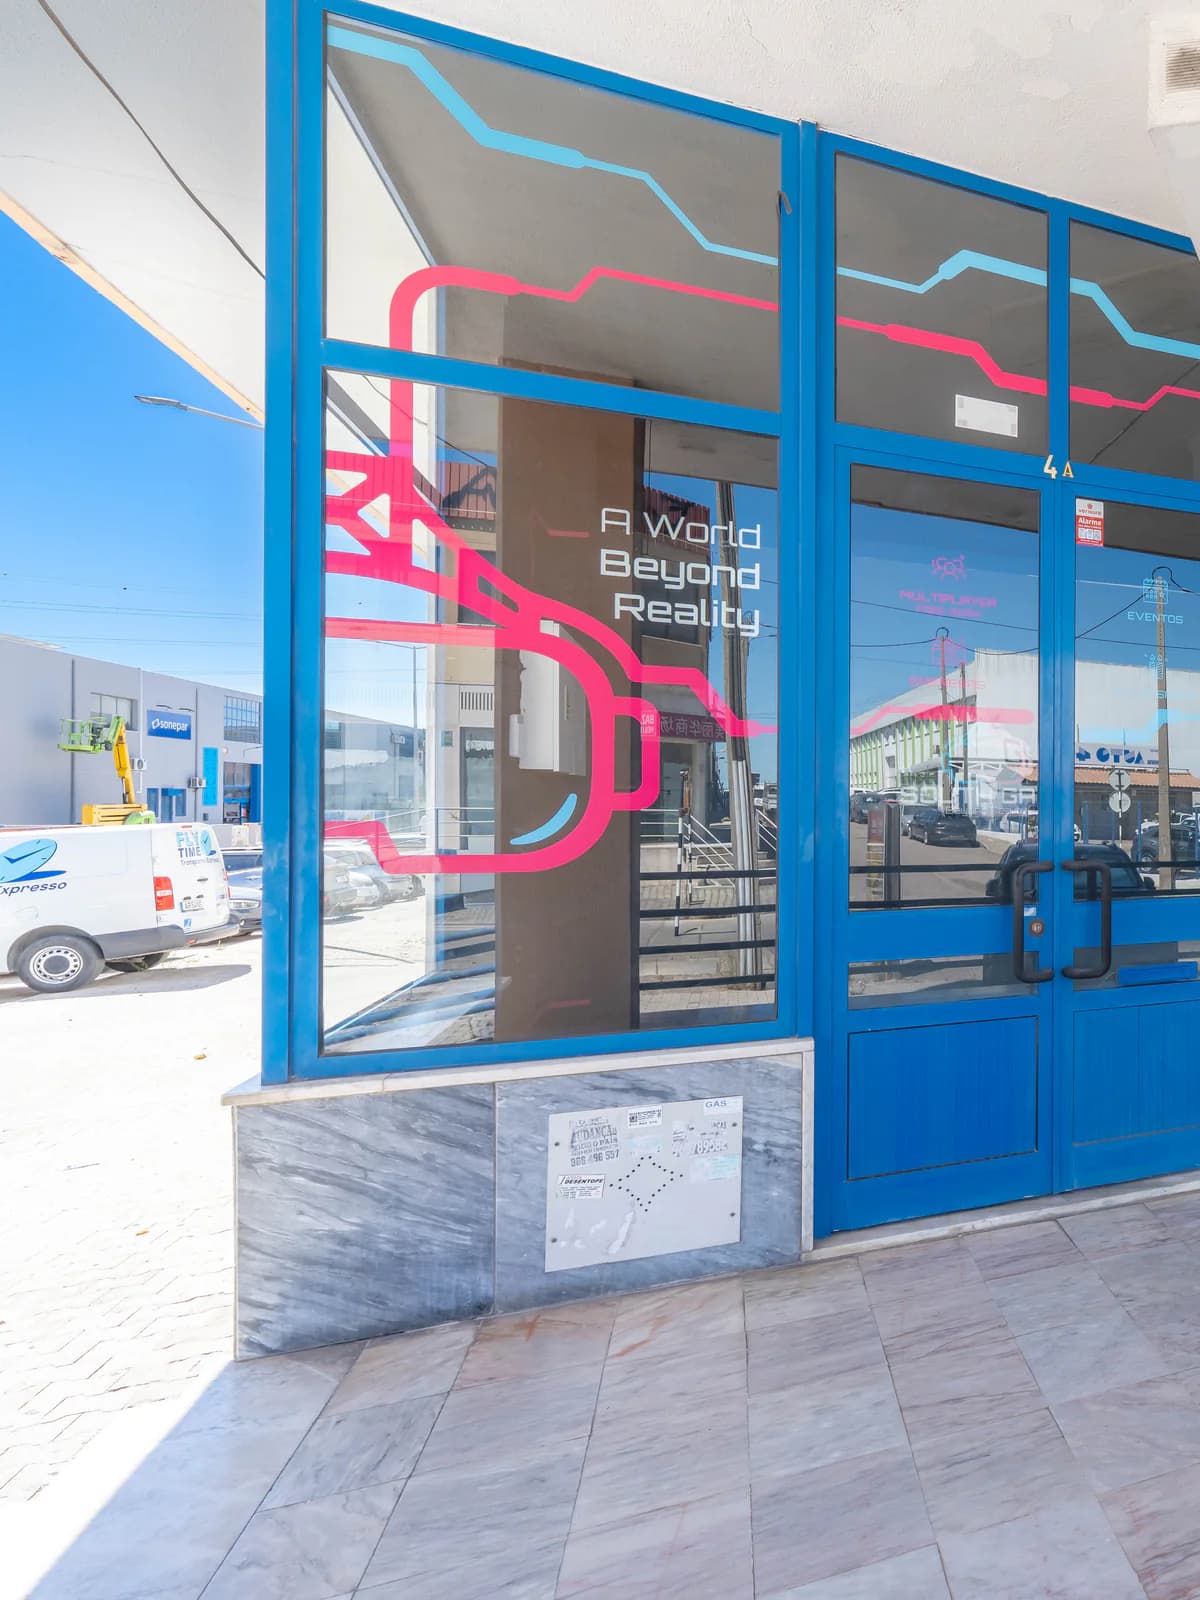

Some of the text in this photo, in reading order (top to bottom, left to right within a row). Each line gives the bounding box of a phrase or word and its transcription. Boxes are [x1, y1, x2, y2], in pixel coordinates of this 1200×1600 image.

[1043, 454, 1074, 479] 4 A
[601, 507, 761, 550] A World
[600, 548, 760, 590] Beyond
[614, 592, 760, 638] Reality
[1127, 611, 1184, 625] EVENTOS
[160, 720, 188, 732] sonepar
[176, 831, 199, 847] FLY
[178, 847, 202, 858] TIME
[705, 1100, 727, 1109] GAS
